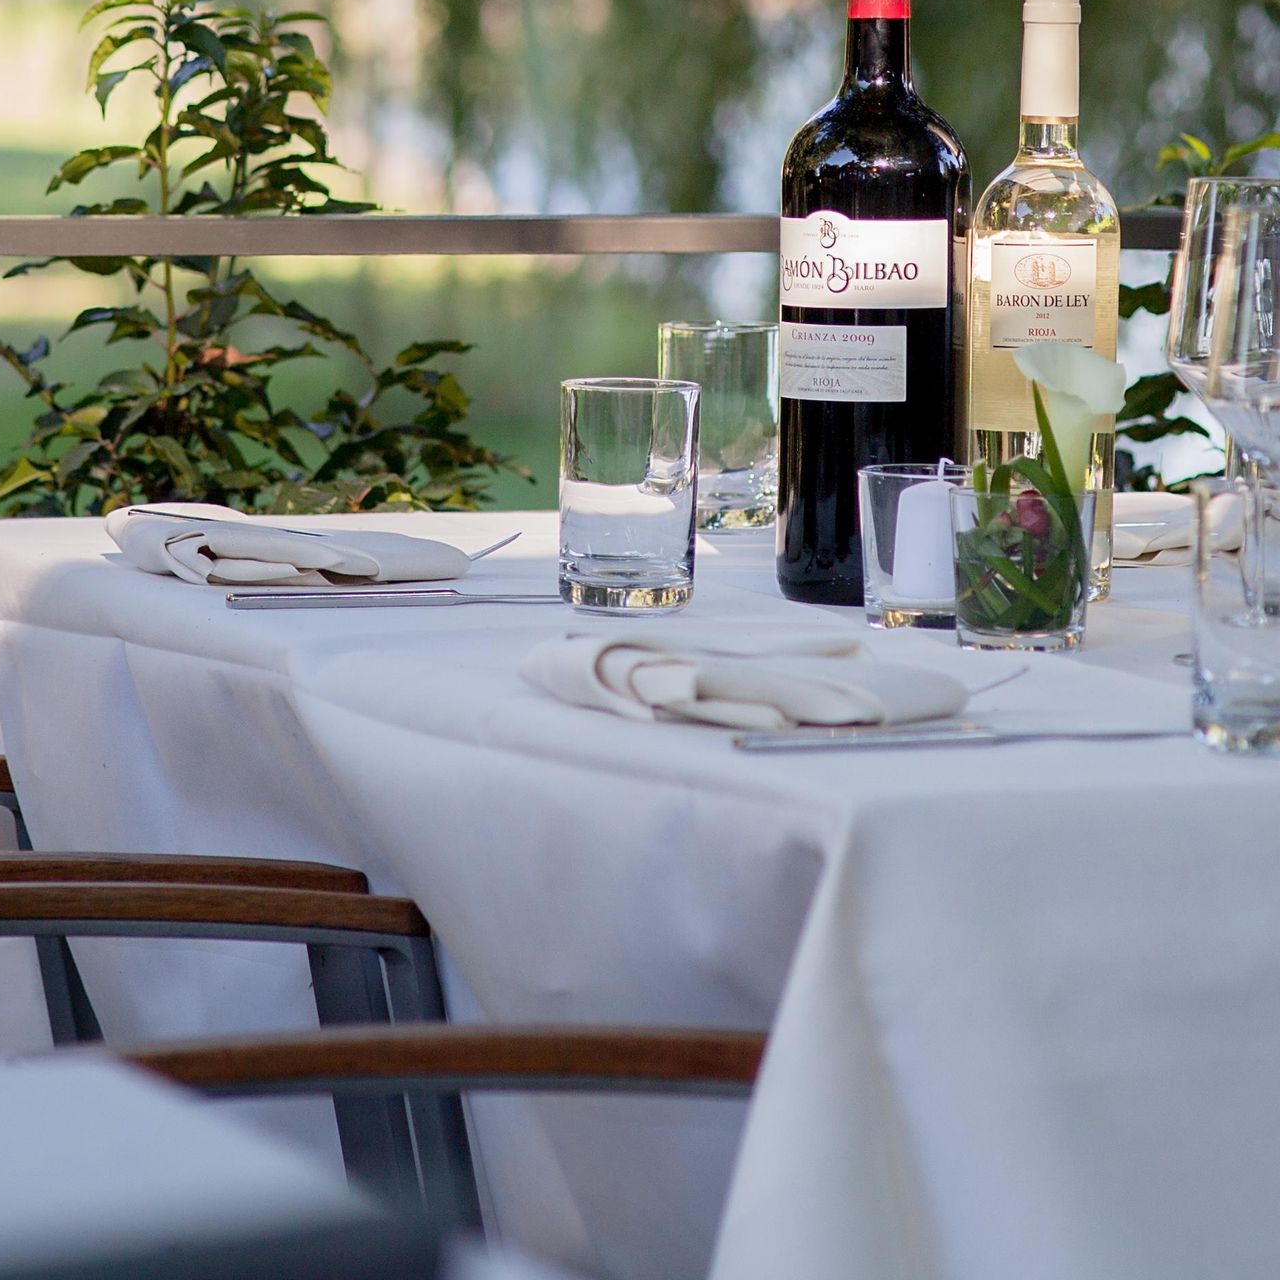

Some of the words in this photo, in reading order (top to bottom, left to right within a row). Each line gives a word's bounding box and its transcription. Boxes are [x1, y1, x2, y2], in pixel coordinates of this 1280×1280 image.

[826, 254, 919, 294] BILBAO
[996, 294, 1040, 308] BARON
[1043, 294, 1064, 308] DE
[1066, 294, 1091, 308] LEY
[1035, 312, 1050, 320] 2012
[1028, 328, 1057, 337] RIOJA
[842, 334, 875, 346] 2009
[812, 377, 841, 388] RIOJA
